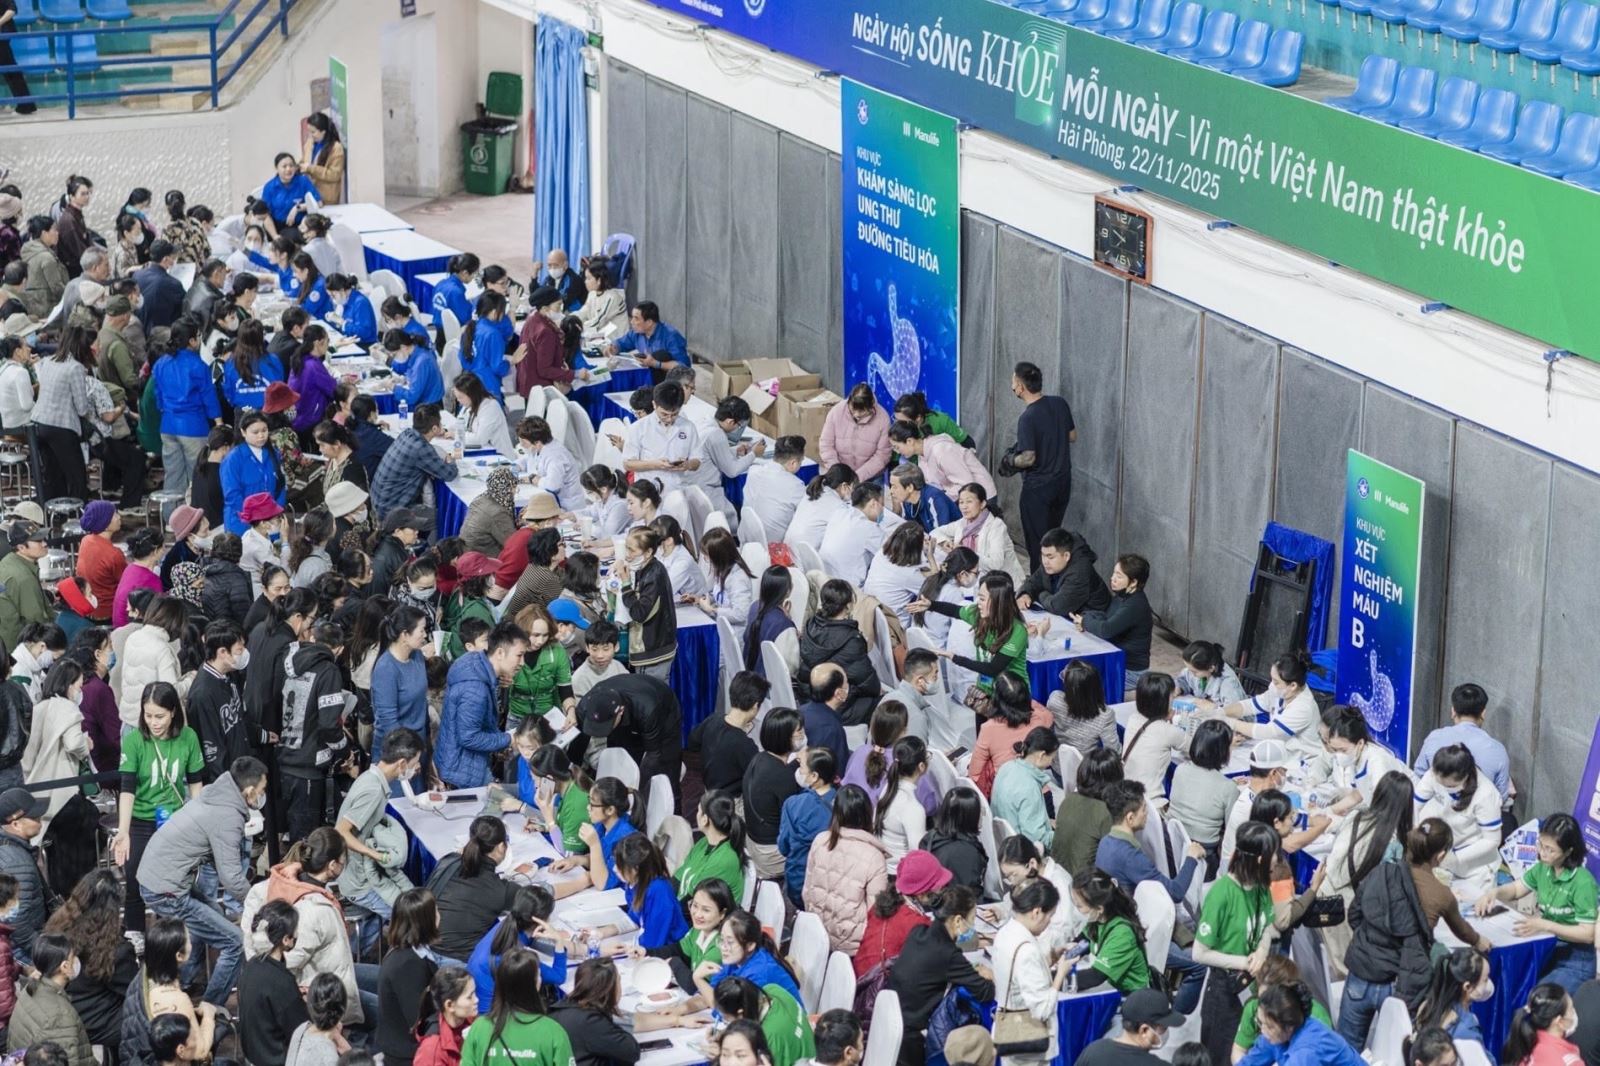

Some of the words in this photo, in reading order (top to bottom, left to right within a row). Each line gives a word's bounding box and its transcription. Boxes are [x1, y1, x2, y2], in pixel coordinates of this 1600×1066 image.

[853, 12, 889, 47] NGÀY
[890, 22, 915, 61] HỘI
[917, 16, 973, 77] SỐNG
[975, 30, 1060, 106] KHỎE
[1062, 67, 1108, 124] MỖI
[1111, 90, 1179, 147] NGÀY
[1190, 114, 1211, 160] Vì
[1215, 133, 1264, 184] một
[1270, 141, 1317, 203] Việt
[1321, 161, 1384, 222] Nam
[1391, 188, 1450, 250] thật
[1453, 205, 1525, 273] khỏe
[856, 145, 869, 162] KHU
[1057, 119, 1082, 149] Hải
[1082, 128, 1126, 171] Phòng,
[1129, 145, 1221, 201] 22/11/2025
[857, 167, 886, 196] KHÁM
[887, 177, 915, 208] SÀNG
[916, 191, 937, 218] LỌC
[858, 193, 879, 220] UNG
[880, 203, 901, 229] THƯ
[858, 221, 892, 254] ĐƯỜNG
[893, 237, 916, 264] TIÊU
[917, 247, 940, 275] HÓA
[1356, 516, 1371, 534] KHU
[1372, 523, 1386, 541] VỰC
[1354, 537, 1378, 564] XÉT
[1354, 564, 1403, 605] NGHIỆM
[1352, 590, 1380, 620] MÁU
[1352, 616, 1365, 649] B
